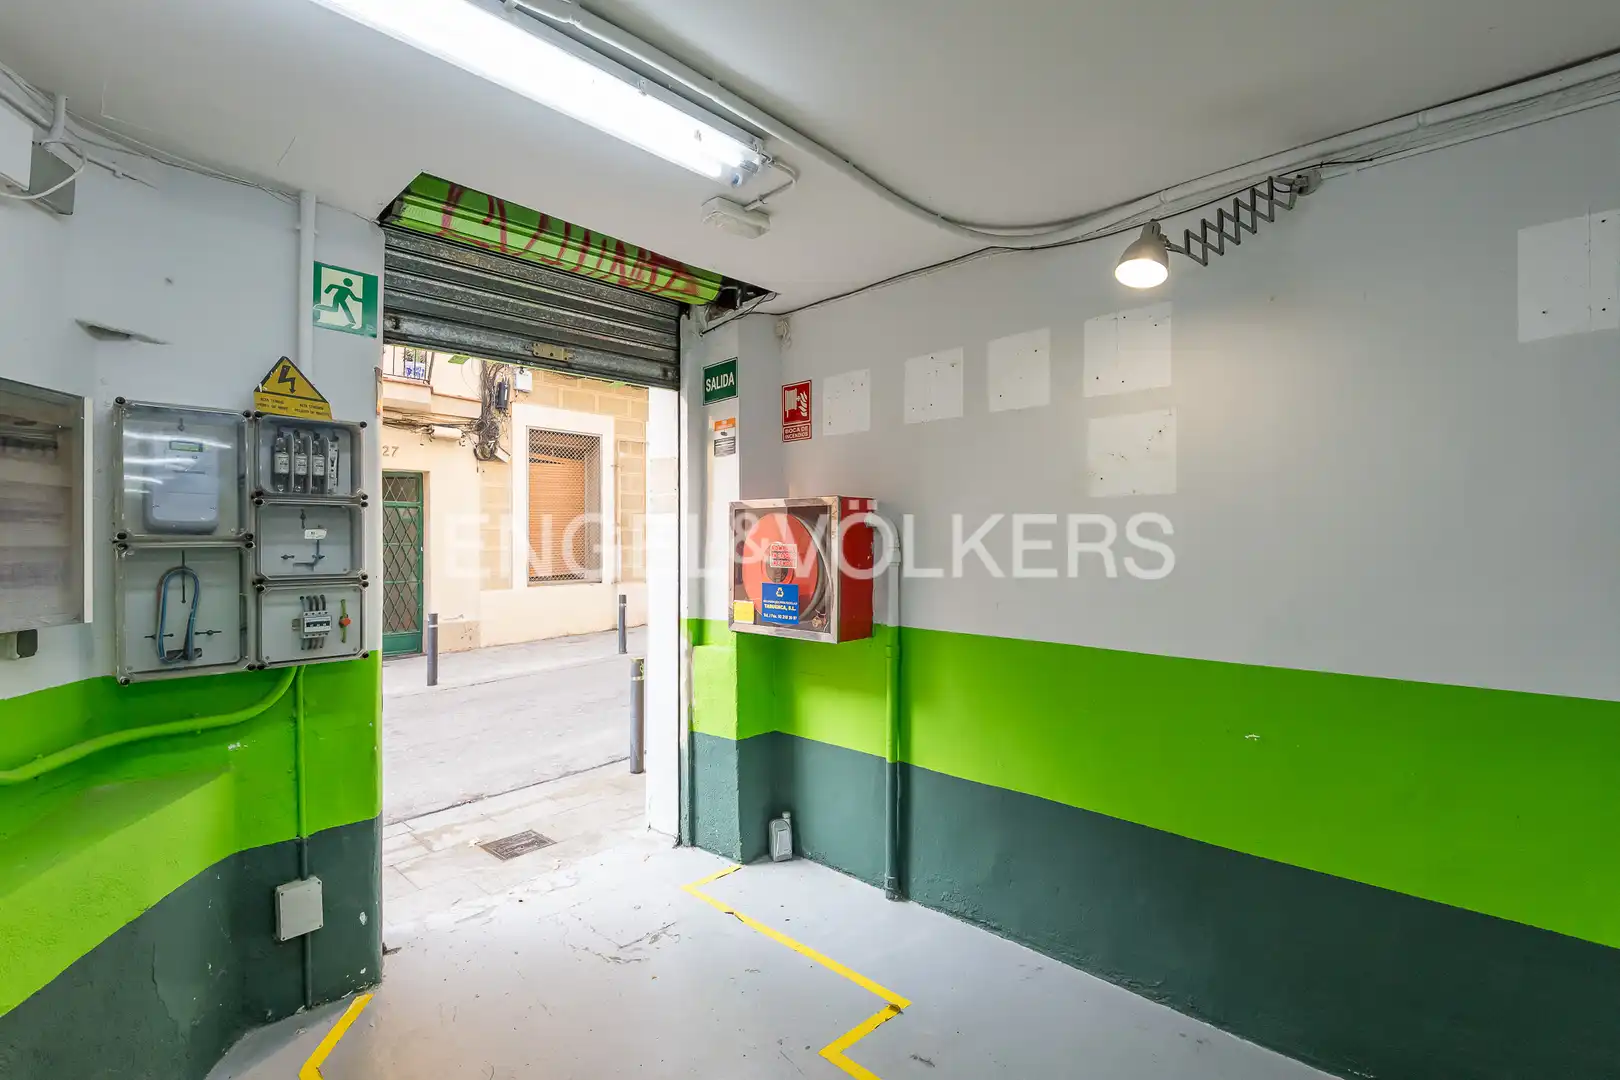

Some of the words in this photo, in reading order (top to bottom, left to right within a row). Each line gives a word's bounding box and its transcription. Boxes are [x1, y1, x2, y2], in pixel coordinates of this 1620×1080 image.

[705, 371, 735, 392] SALIDA
[784, 427, 801, 435] BOCA
[784, 431, 809, 439] INCENDIOS
[382, 445, 399, 457] 27
